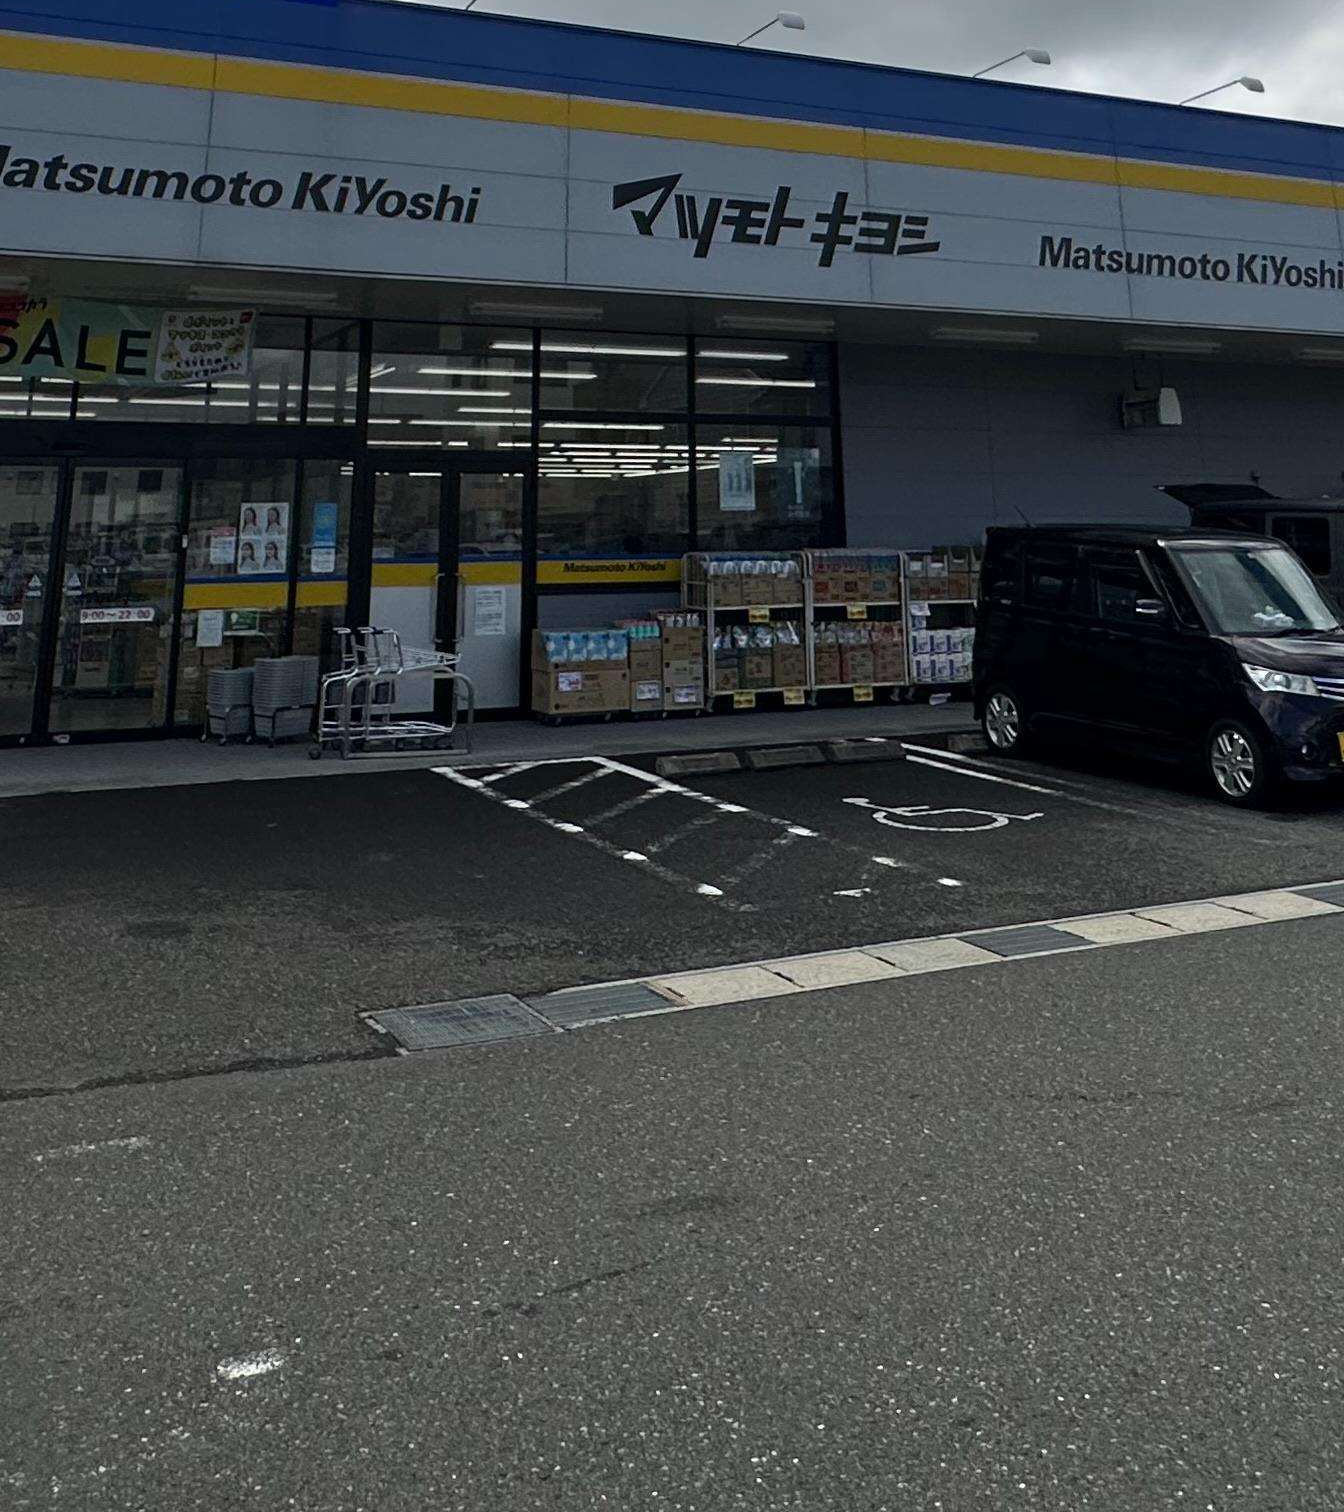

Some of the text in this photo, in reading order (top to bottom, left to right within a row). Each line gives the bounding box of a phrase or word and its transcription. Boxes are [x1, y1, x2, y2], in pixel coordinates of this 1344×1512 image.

[291, 171, 483, 224] KiYoshi
[612, 173, 941, 268] マツモトキヨシ
[1038, 235, 1231, 283] Matsumoto
